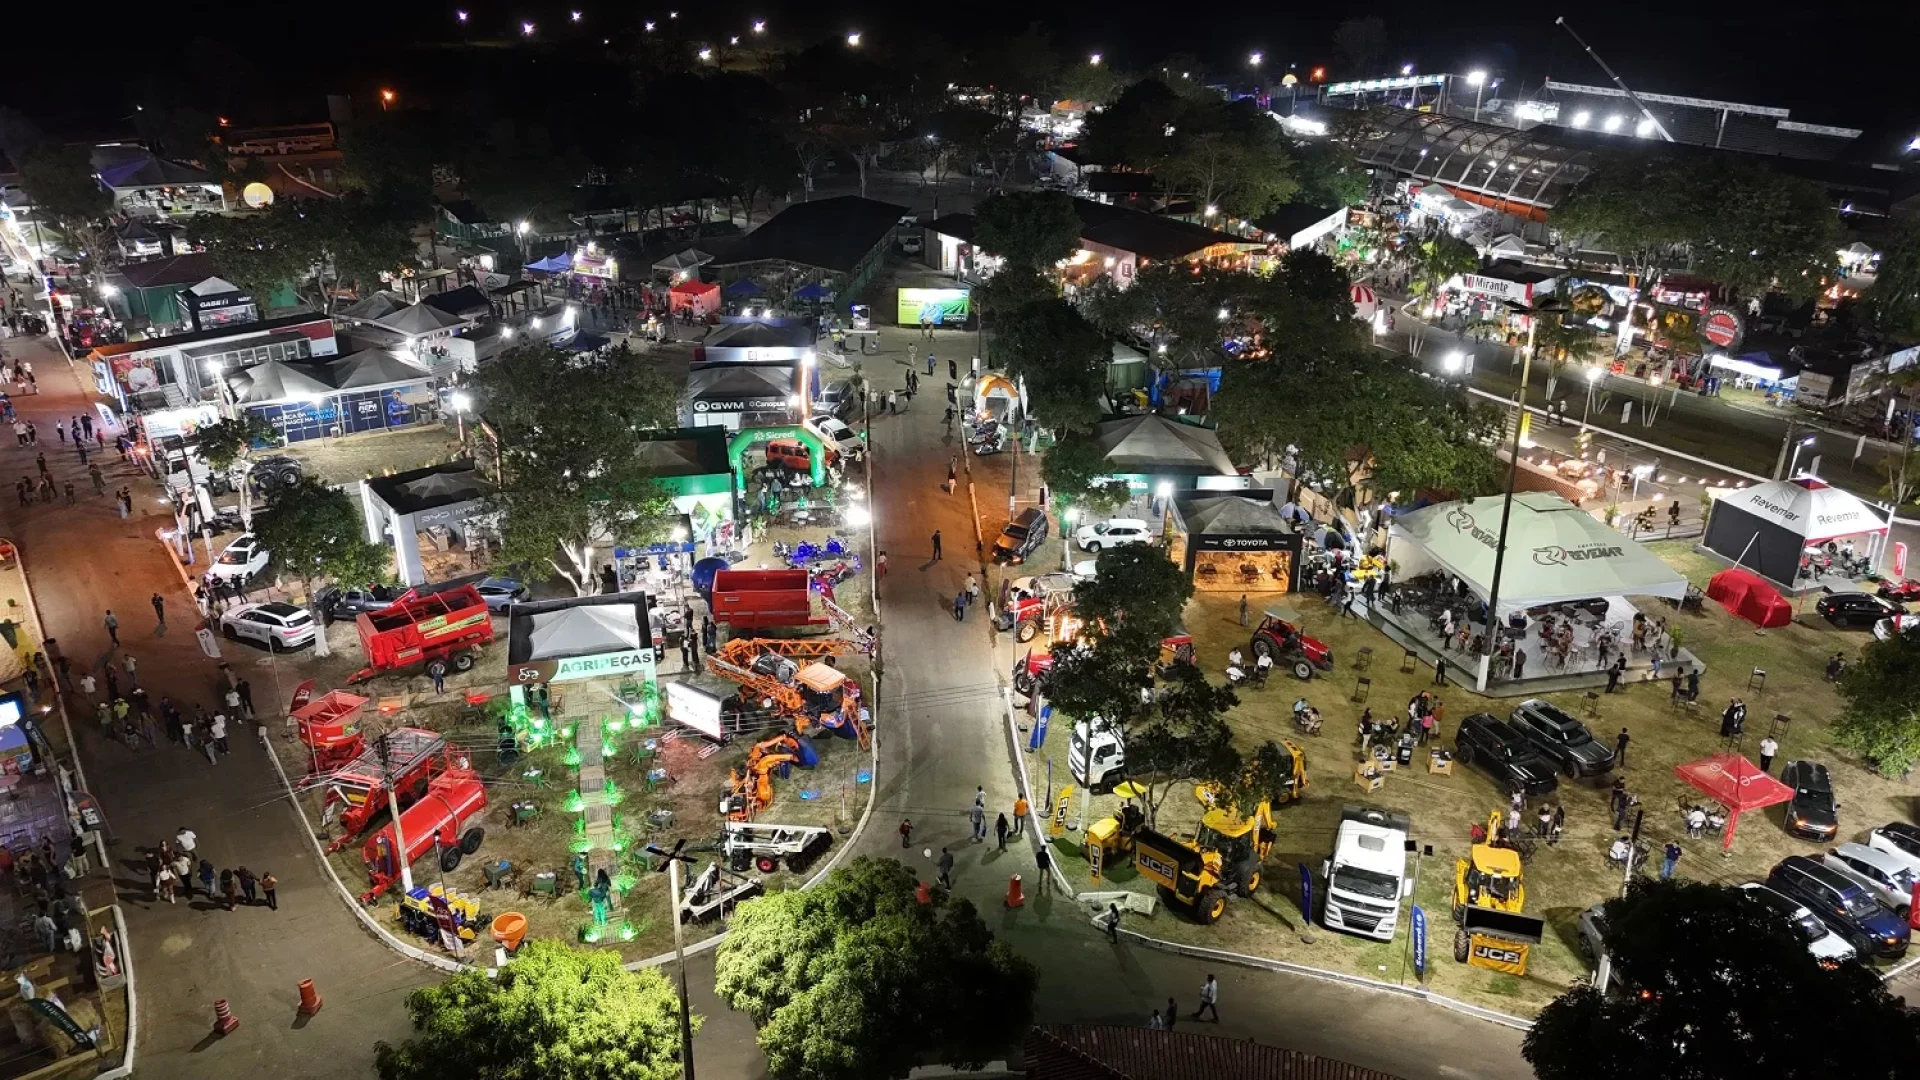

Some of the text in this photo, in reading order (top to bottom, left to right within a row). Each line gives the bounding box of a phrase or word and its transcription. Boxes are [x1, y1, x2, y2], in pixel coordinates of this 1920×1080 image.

[1475, 277, 1508, 293] Mirante
[711, 402, 744, 410] GWM
[766, 429, 796, 439] Sicredi
[1750, 495, 1800, 522] Revemar
[1816, 511, 1860, 526] Revemar
[560, 653, 652, 674] AGRIPEÇAS
[1140, 855, 1173, 879] JCB
[1475, 946, 1519, 963] JCB
